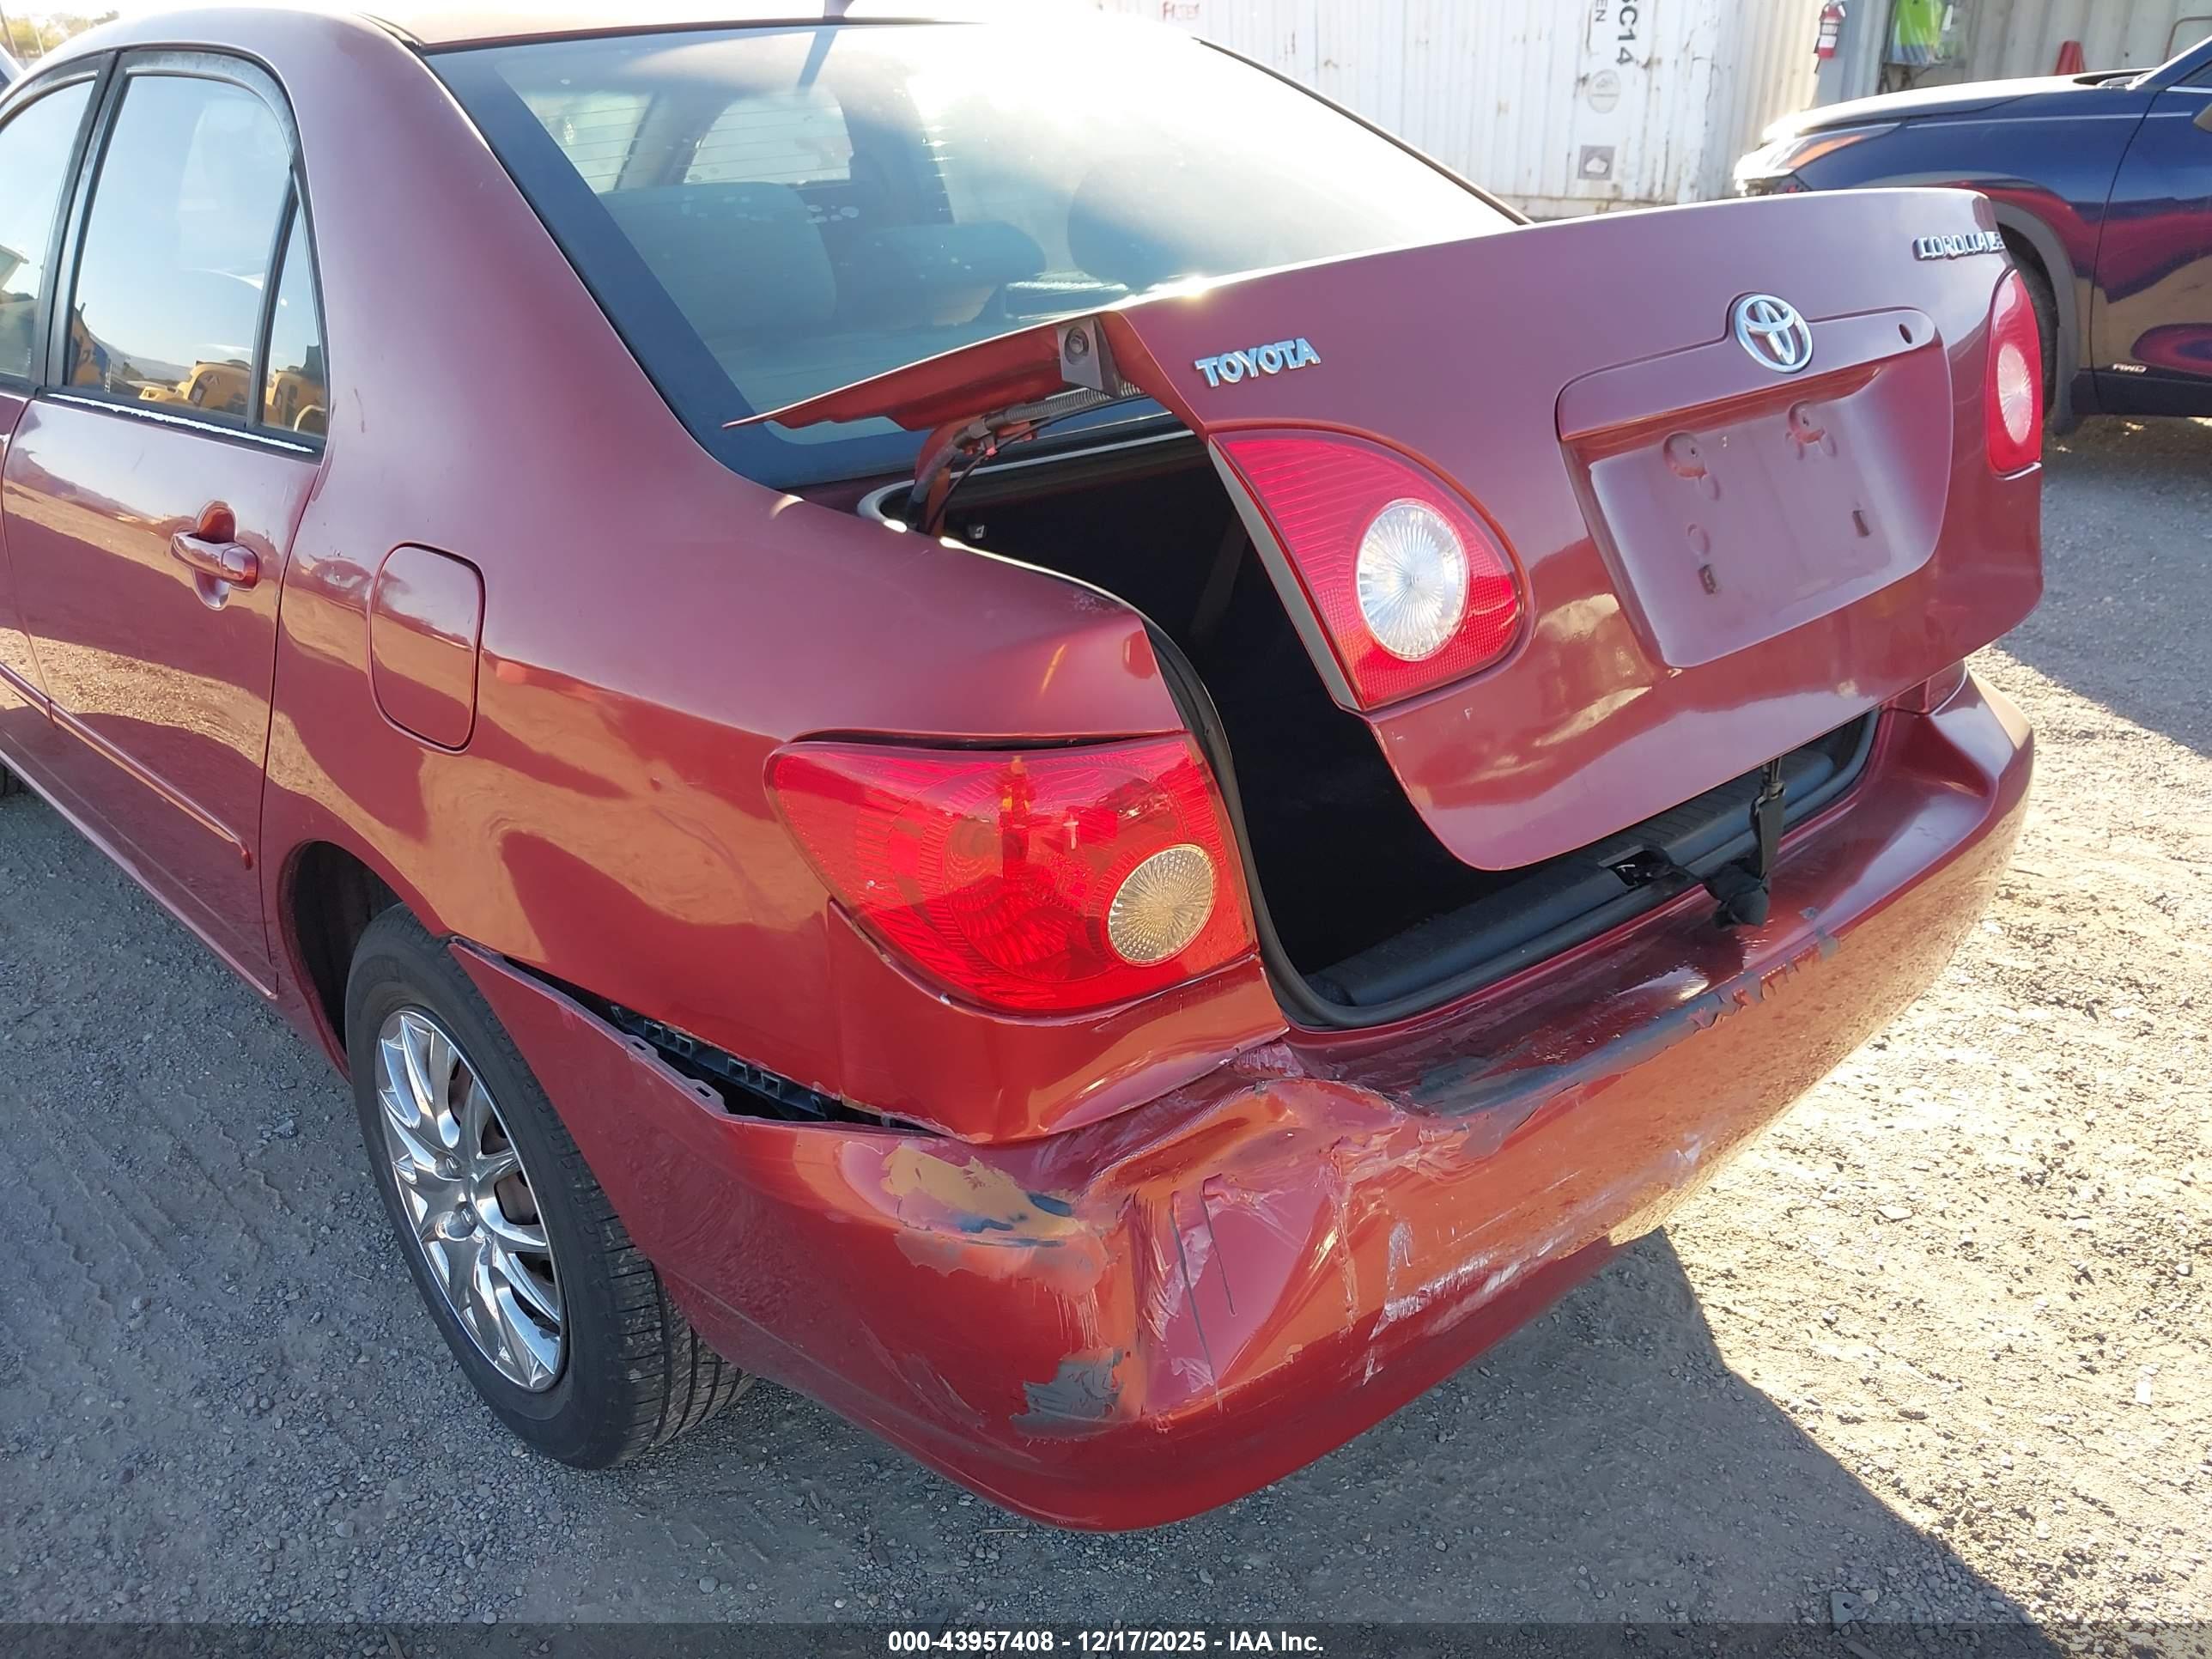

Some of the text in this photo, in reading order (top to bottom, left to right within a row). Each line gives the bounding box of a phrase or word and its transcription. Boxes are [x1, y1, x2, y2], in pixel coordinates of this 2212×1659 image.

[1616, 0, 1638, 65] C14
[1916, 233, 1990, 259] COROLLA
[1194, 337, 1322, 388] TOYOTA
[2112, 362, 2148, 374] AWD
